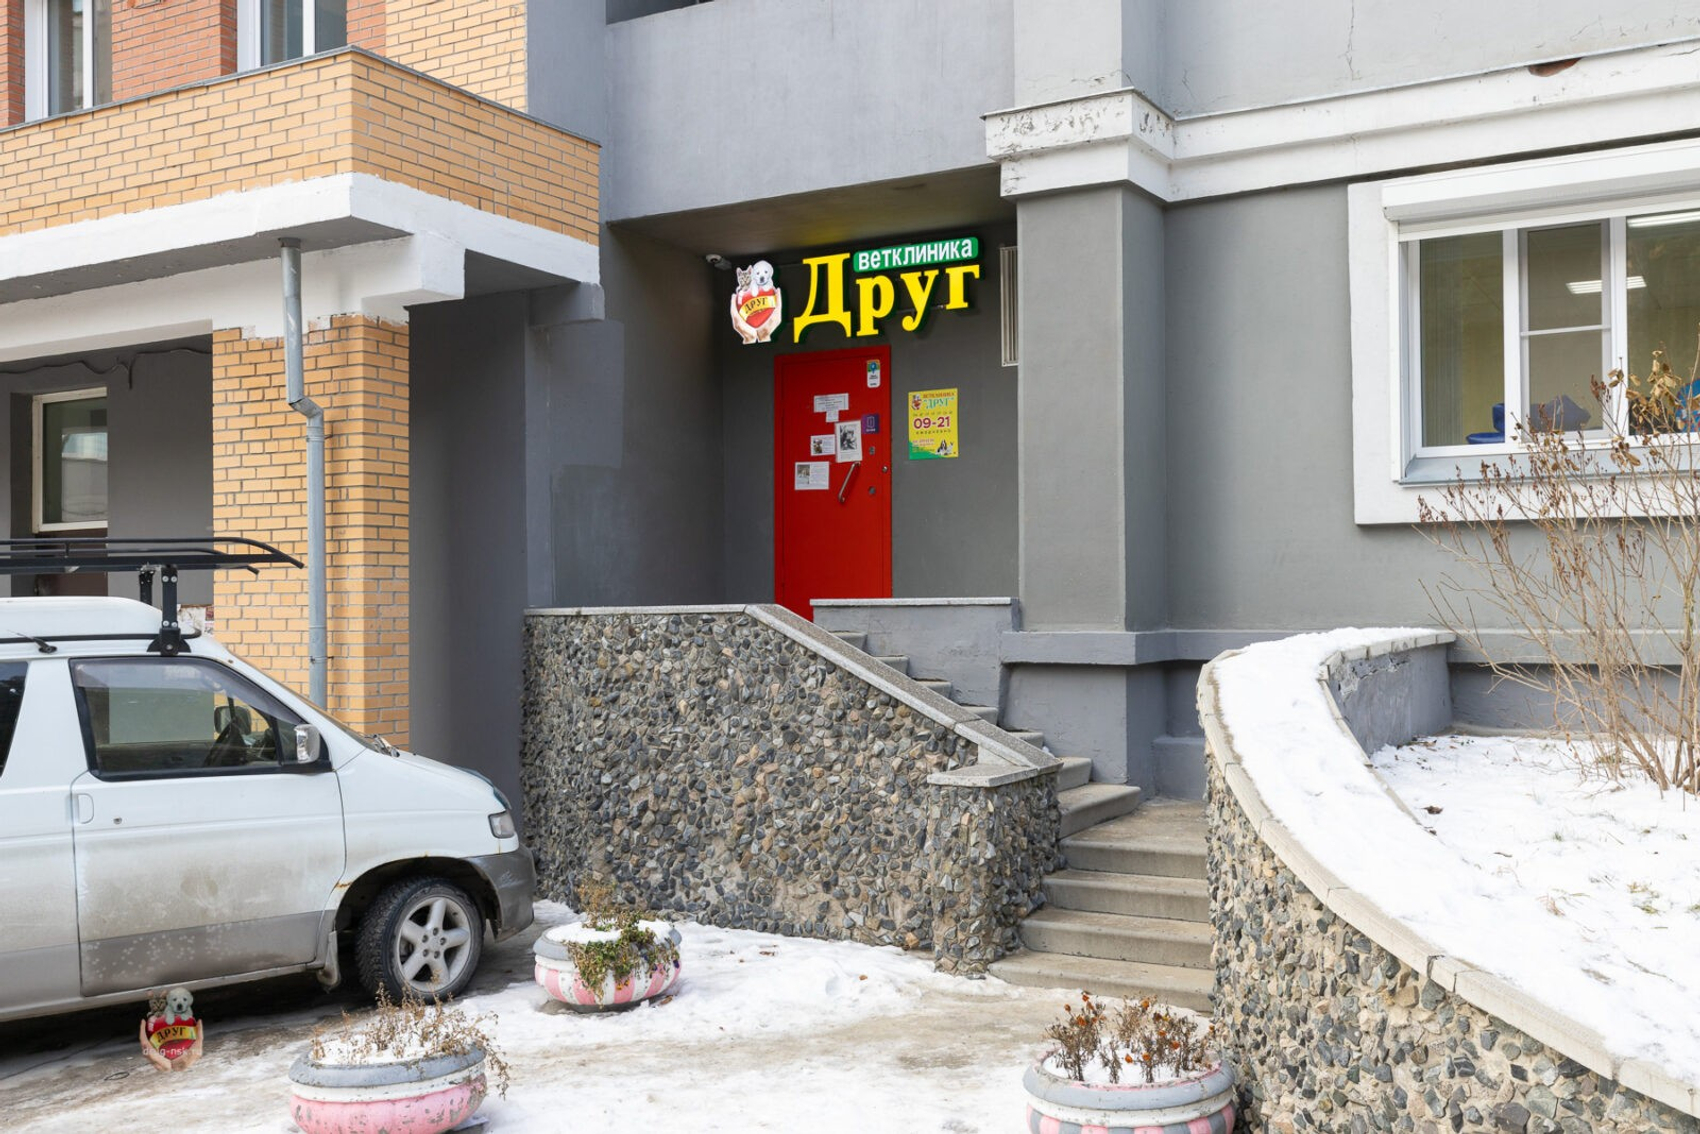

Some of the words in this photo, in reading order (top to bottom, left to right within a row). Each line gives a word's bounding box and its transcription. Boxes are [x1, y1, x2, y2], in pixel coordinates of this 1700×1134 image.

[858, 239, 973, 270] ветклиника
[745, 297, 768, 314] ДРУГ
[793, 252, 980, 343] Друг
[913, 416, 950, 429] 09-21
